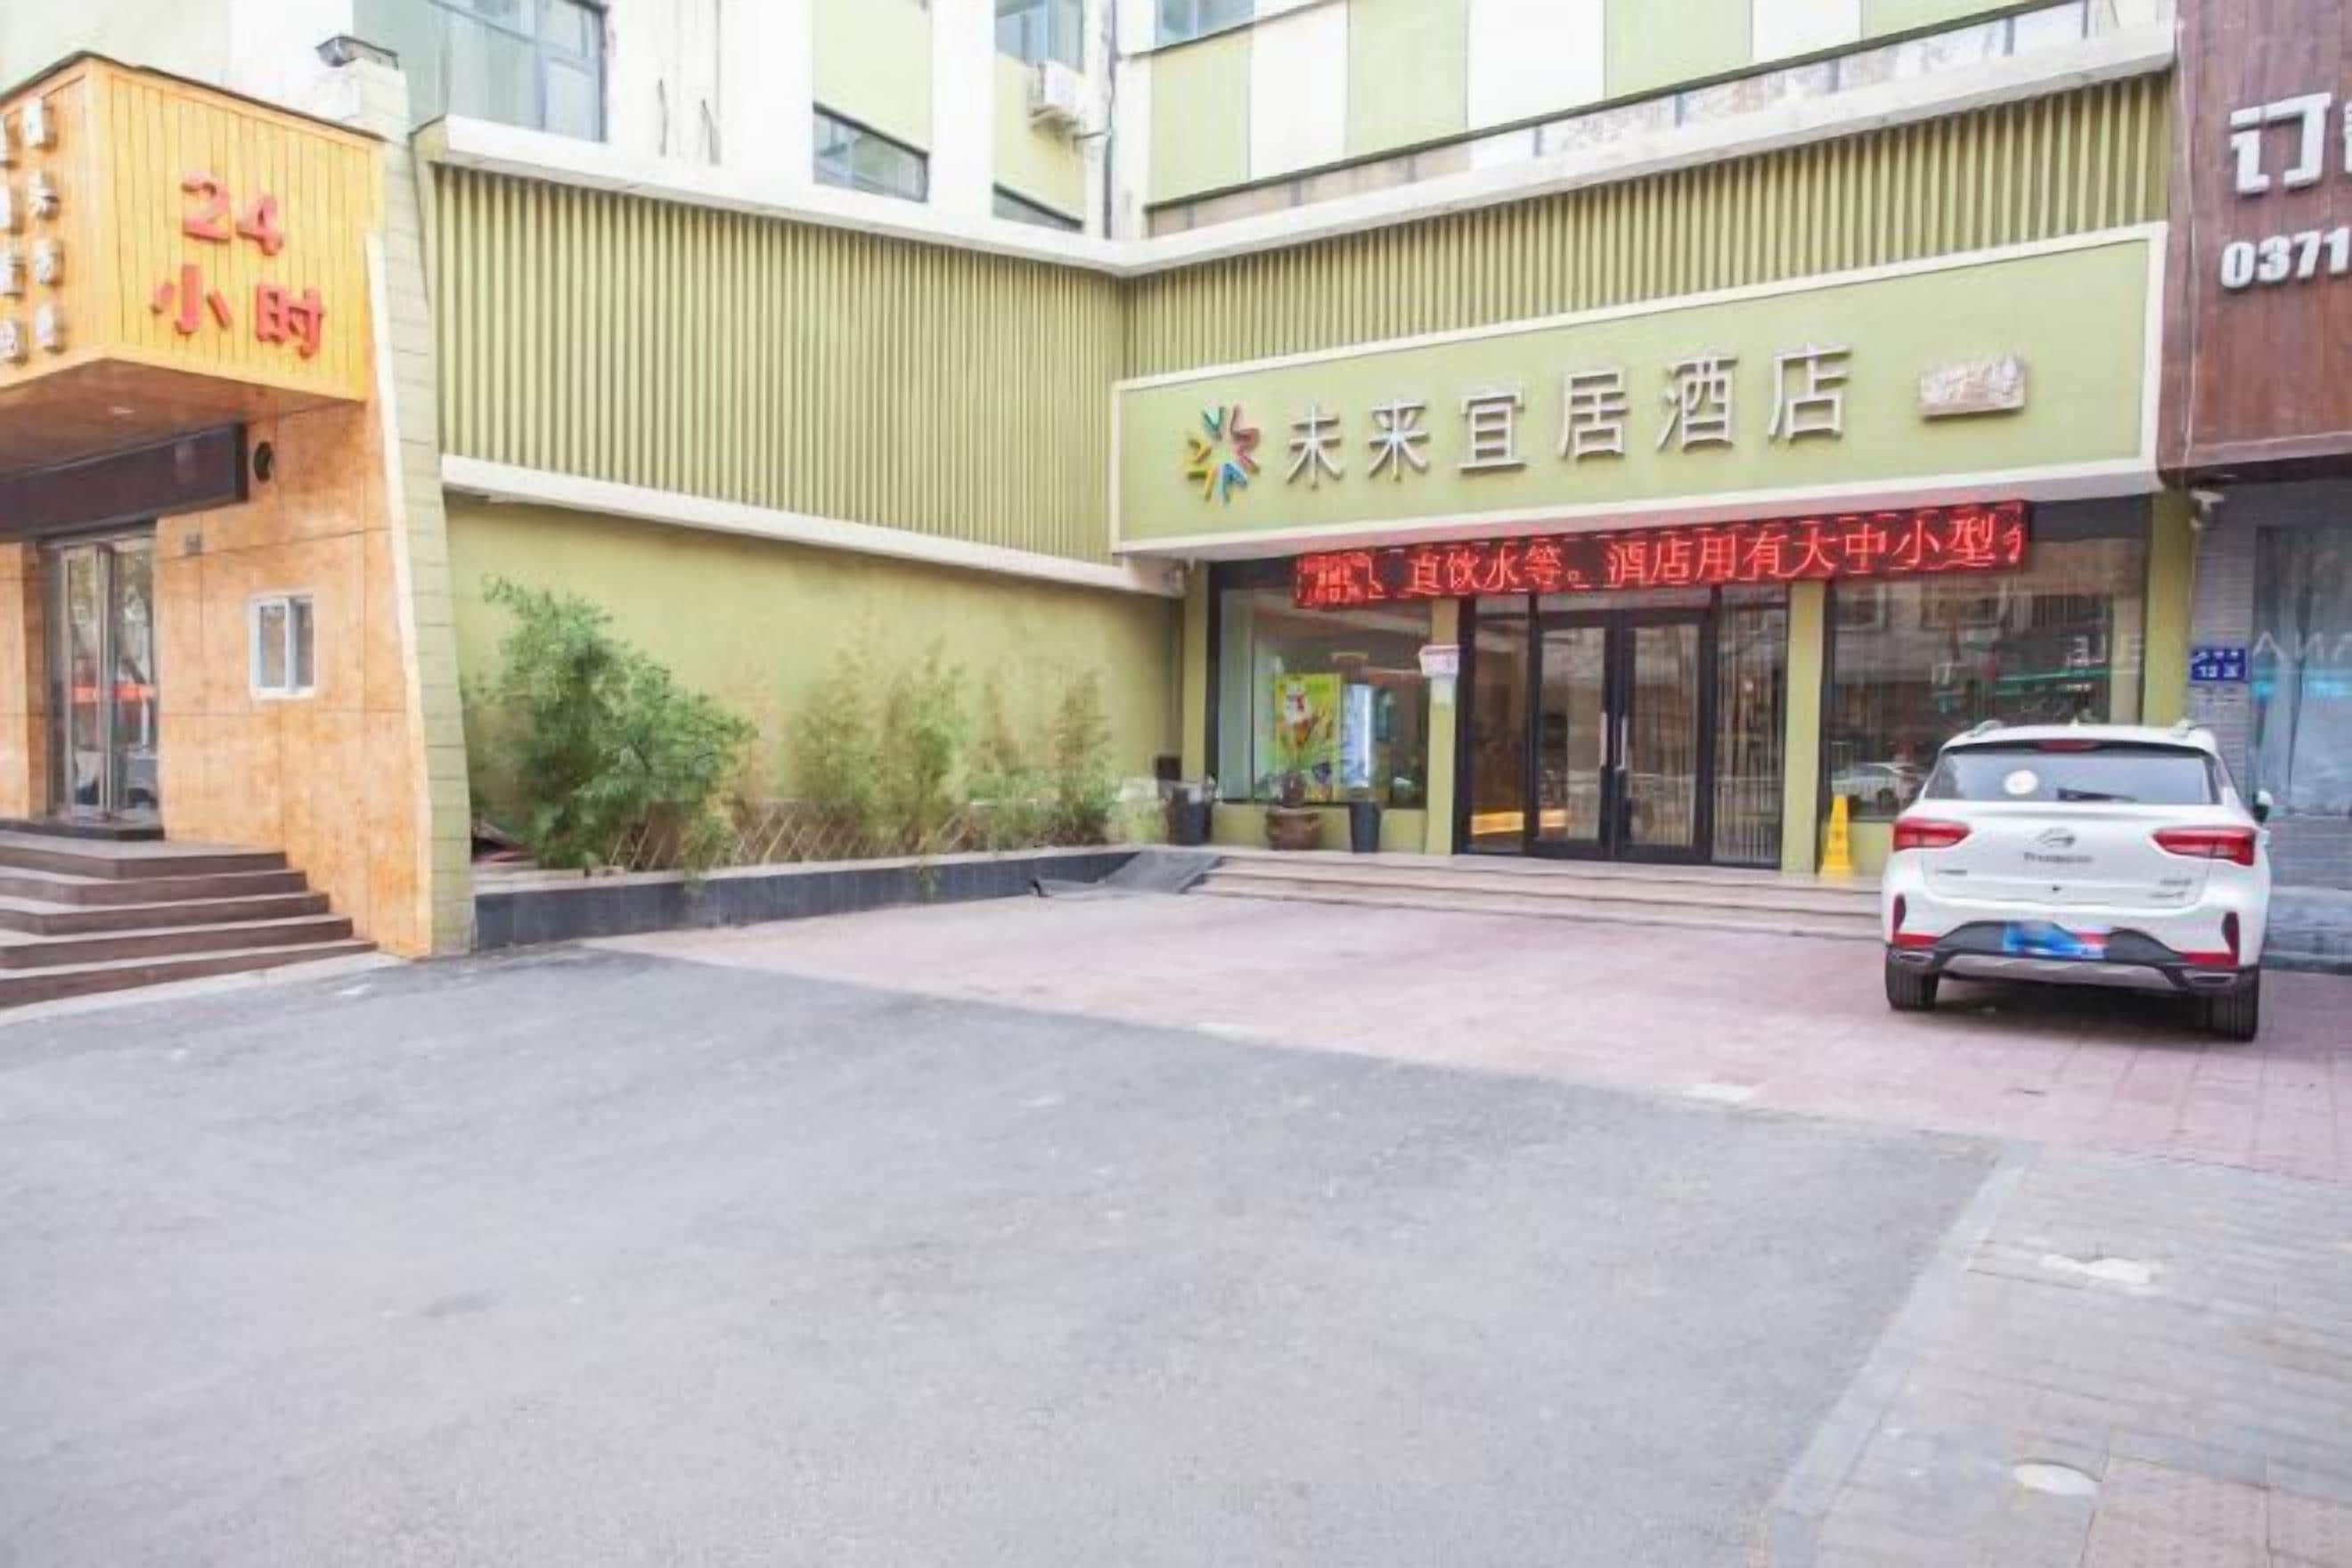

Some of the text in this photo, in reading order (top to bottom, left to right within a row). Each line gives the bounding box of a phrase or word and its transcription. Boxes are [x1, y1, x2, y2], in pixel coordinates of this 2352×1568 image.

[2230, 93, 2352, 194] 订
[180, 169, 284, 257] 24
[2221, 226, 2352, 290] 0371
[150, 264, 325, 359] 小时
[1286, 342, 1854, 490] 未来宜居酒店
